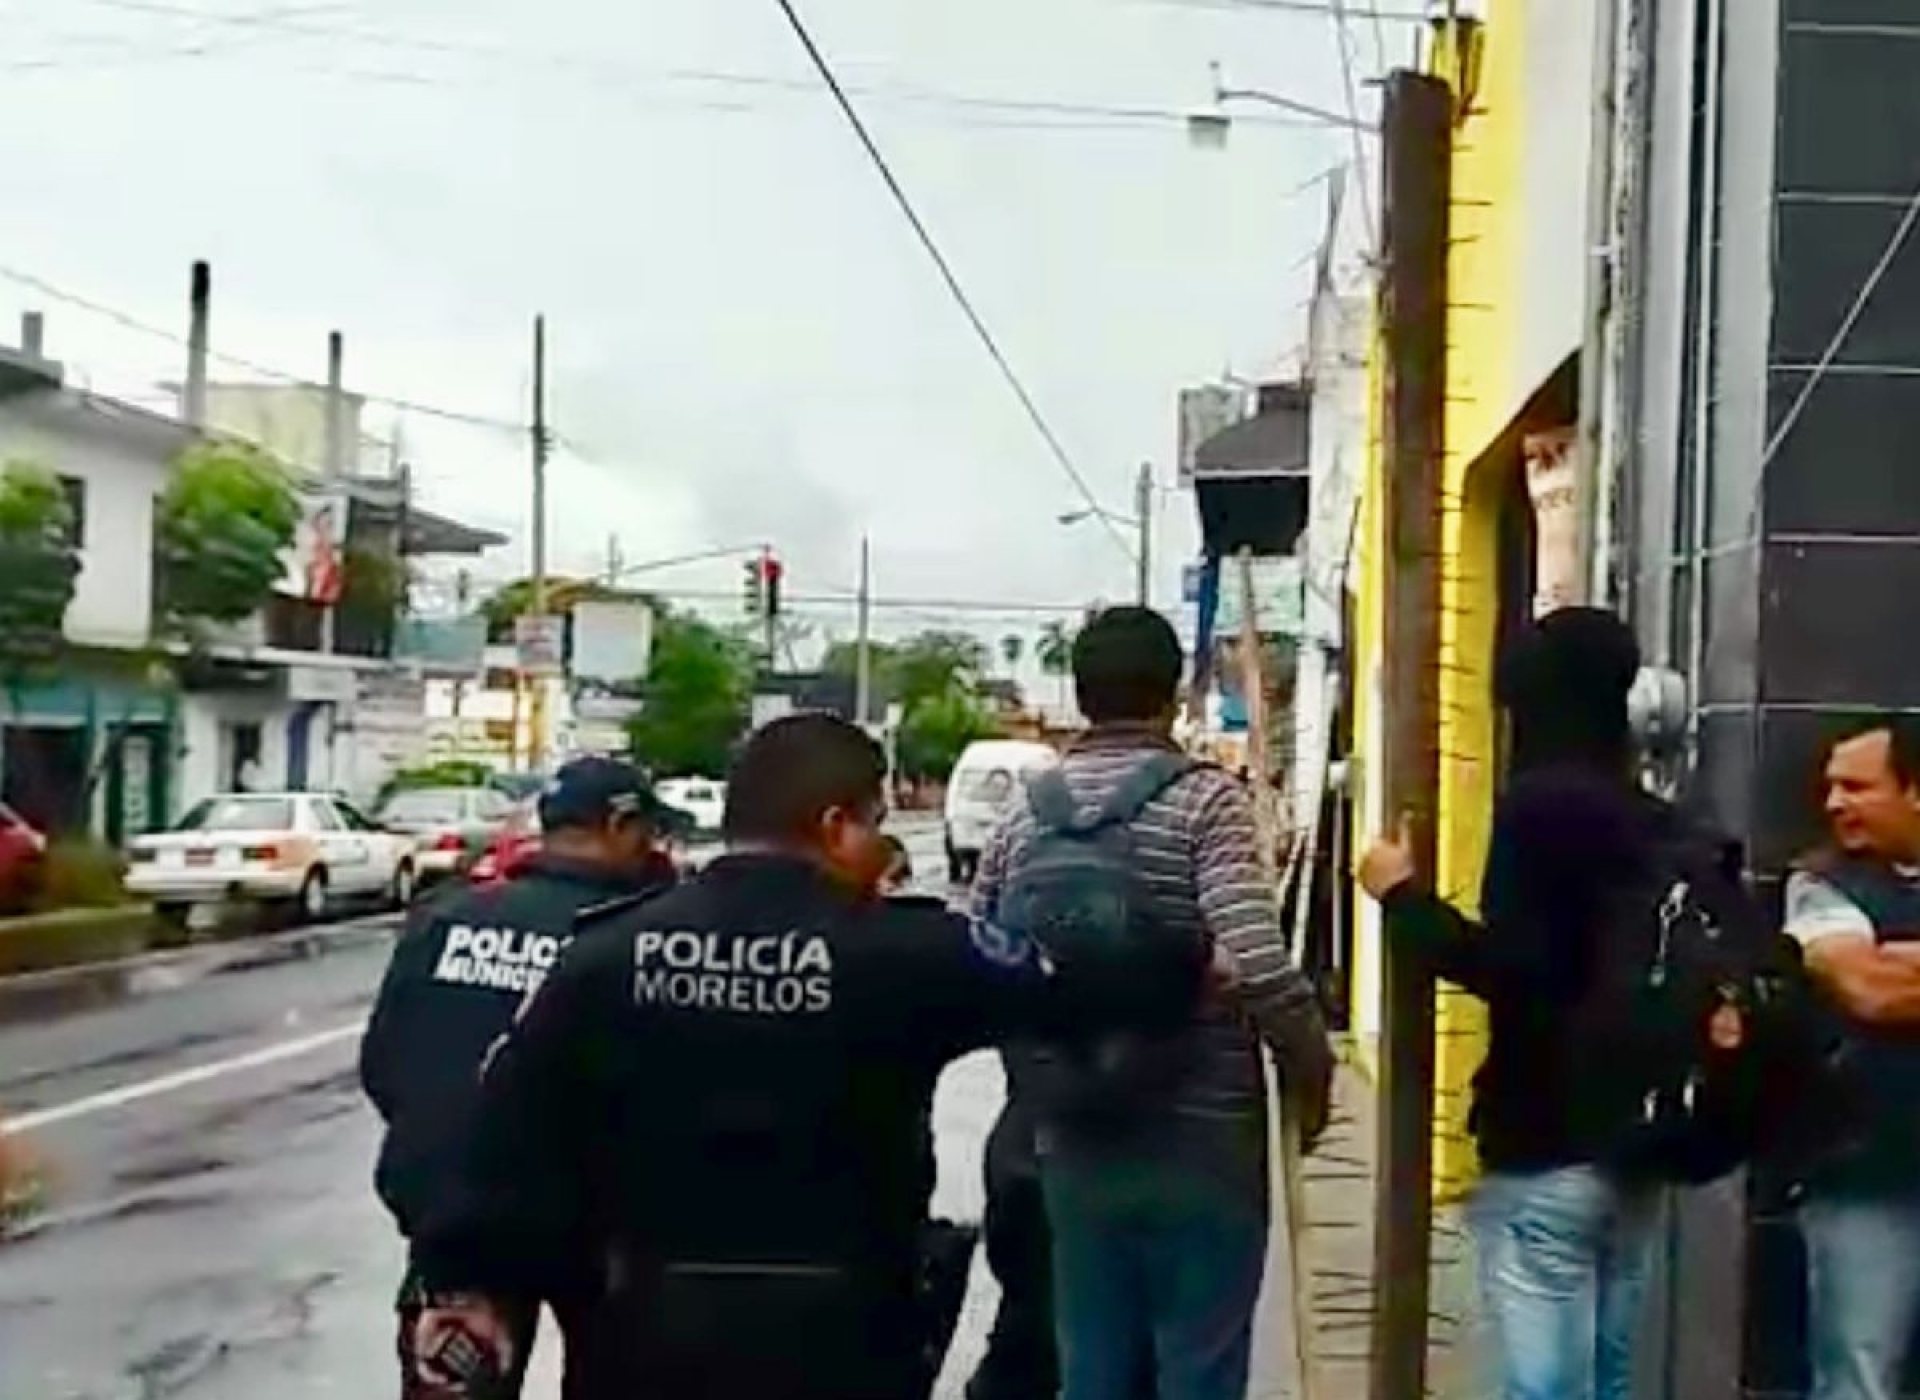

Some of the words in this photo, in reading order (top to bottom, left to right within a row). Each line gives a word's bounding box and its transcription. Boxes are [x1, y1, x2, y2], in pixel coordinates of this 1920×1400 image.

[445, 924, 575, 968] POLIC
[634, 929, 832, 975] POLICÍA
[634, 969, 832, 1013] MORELOS
